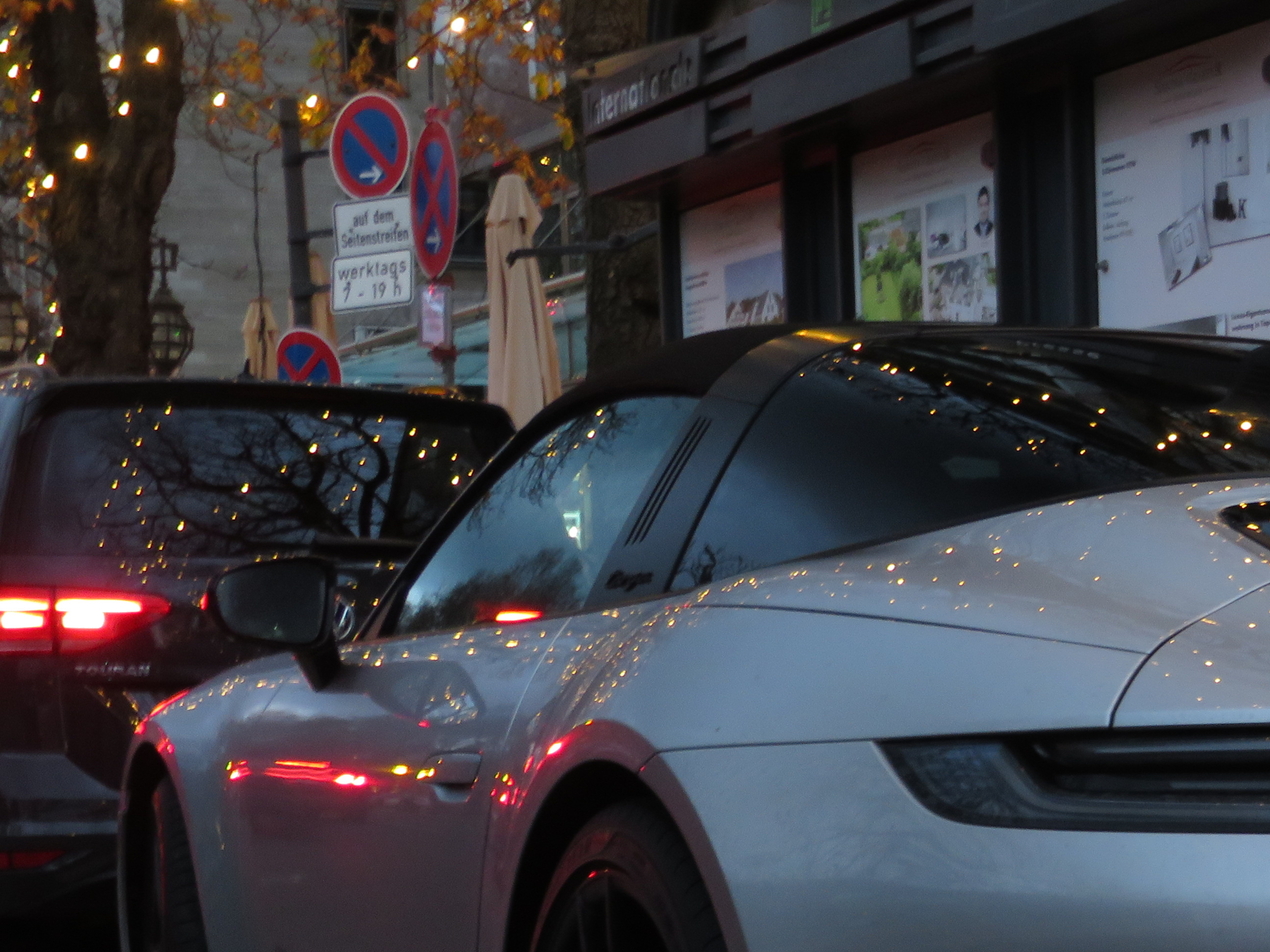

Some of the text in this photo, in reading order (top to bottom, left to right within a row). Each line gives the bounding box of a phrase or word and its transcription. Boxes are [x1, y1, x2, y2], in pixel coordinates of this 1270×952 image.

[353, 209, 394, 228] auf dem
[342, 225, 409, 249] Seitenstreifen
[338, 261, 407, 281] werktags
[343, 281, 352, 304] 7
[372, 281, 387, 300] 19
[393, 279, 402, 298] h
